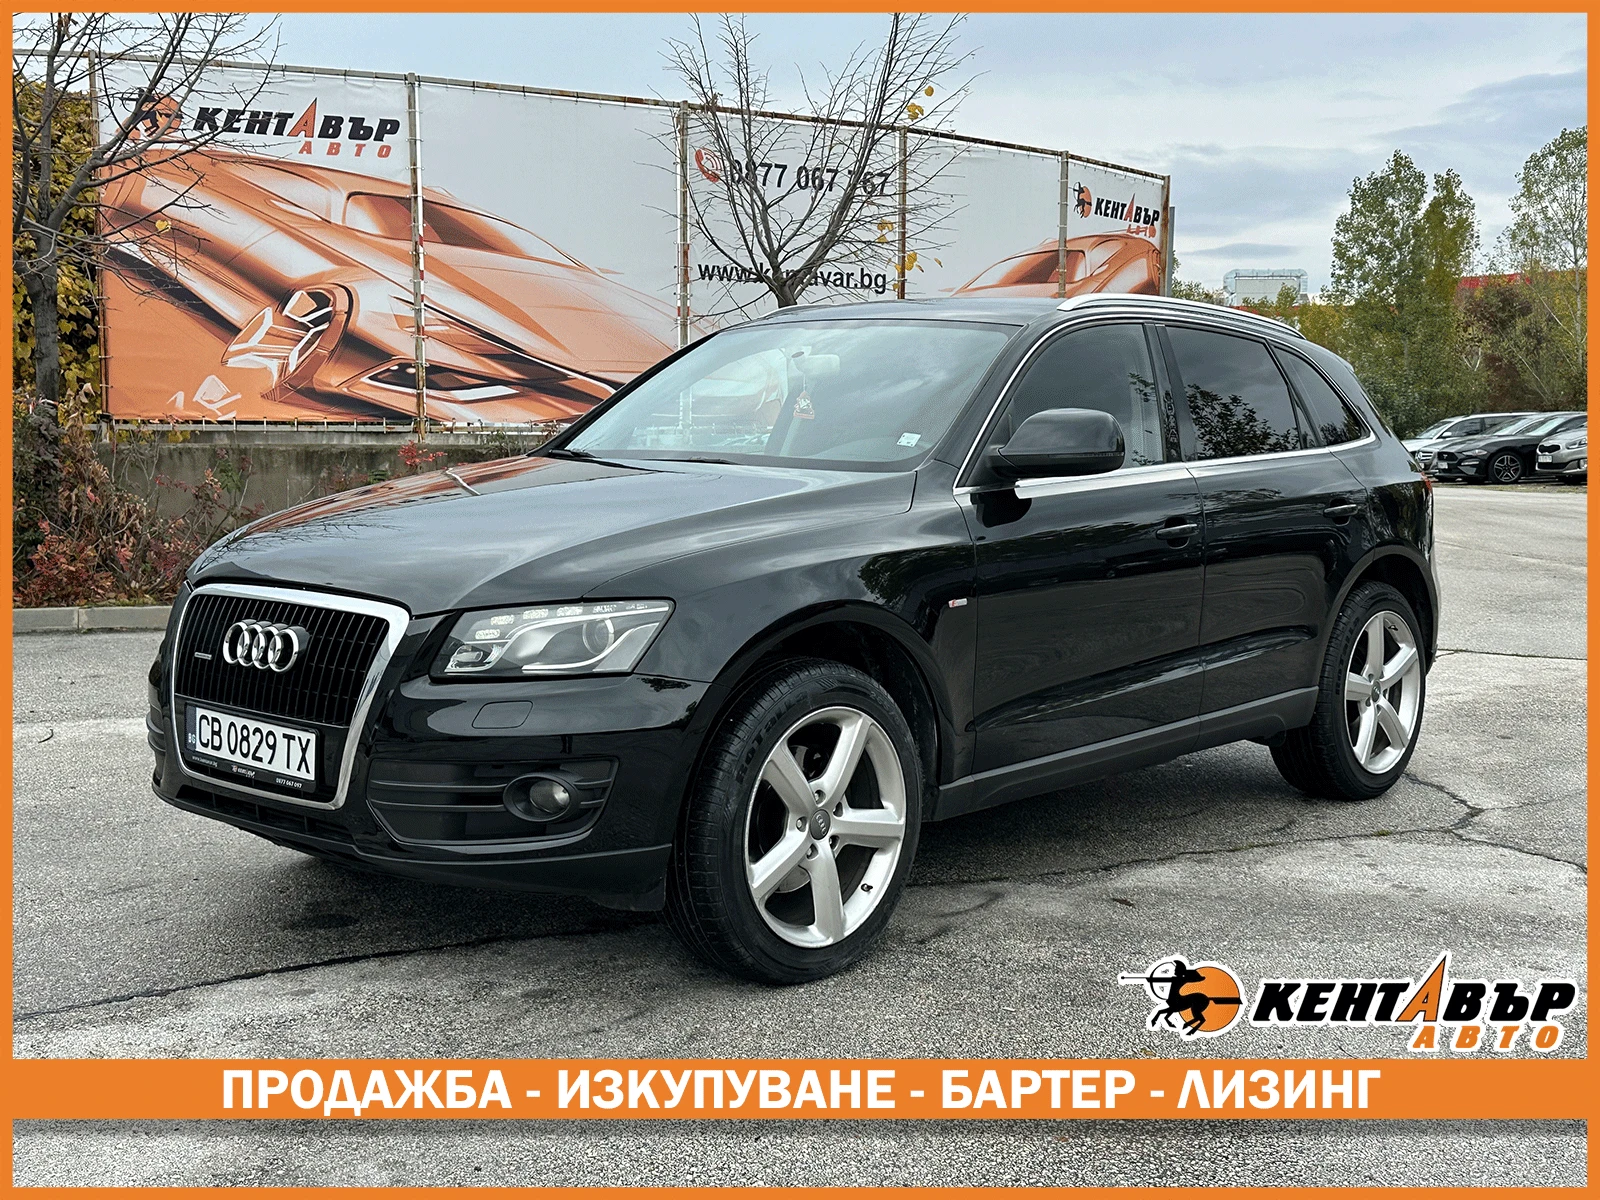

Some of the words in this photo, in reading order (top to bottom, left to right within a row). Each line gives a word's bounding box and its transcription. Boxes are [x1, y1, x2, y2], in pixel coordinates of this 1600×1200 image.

[193, 97, 400, 142] КЕНТАВЪР
[298, 140, 392, 159] АВТО
[796, 165, 839, 192] 067
[847, 170, 890, 196] 67
[1094, 193, 1160, 227] КЕНТАВЪР
[199, 714, 223, 752] CB
[227, 721, 278, 765] 0829
[281, 732, 311, 775] TX
